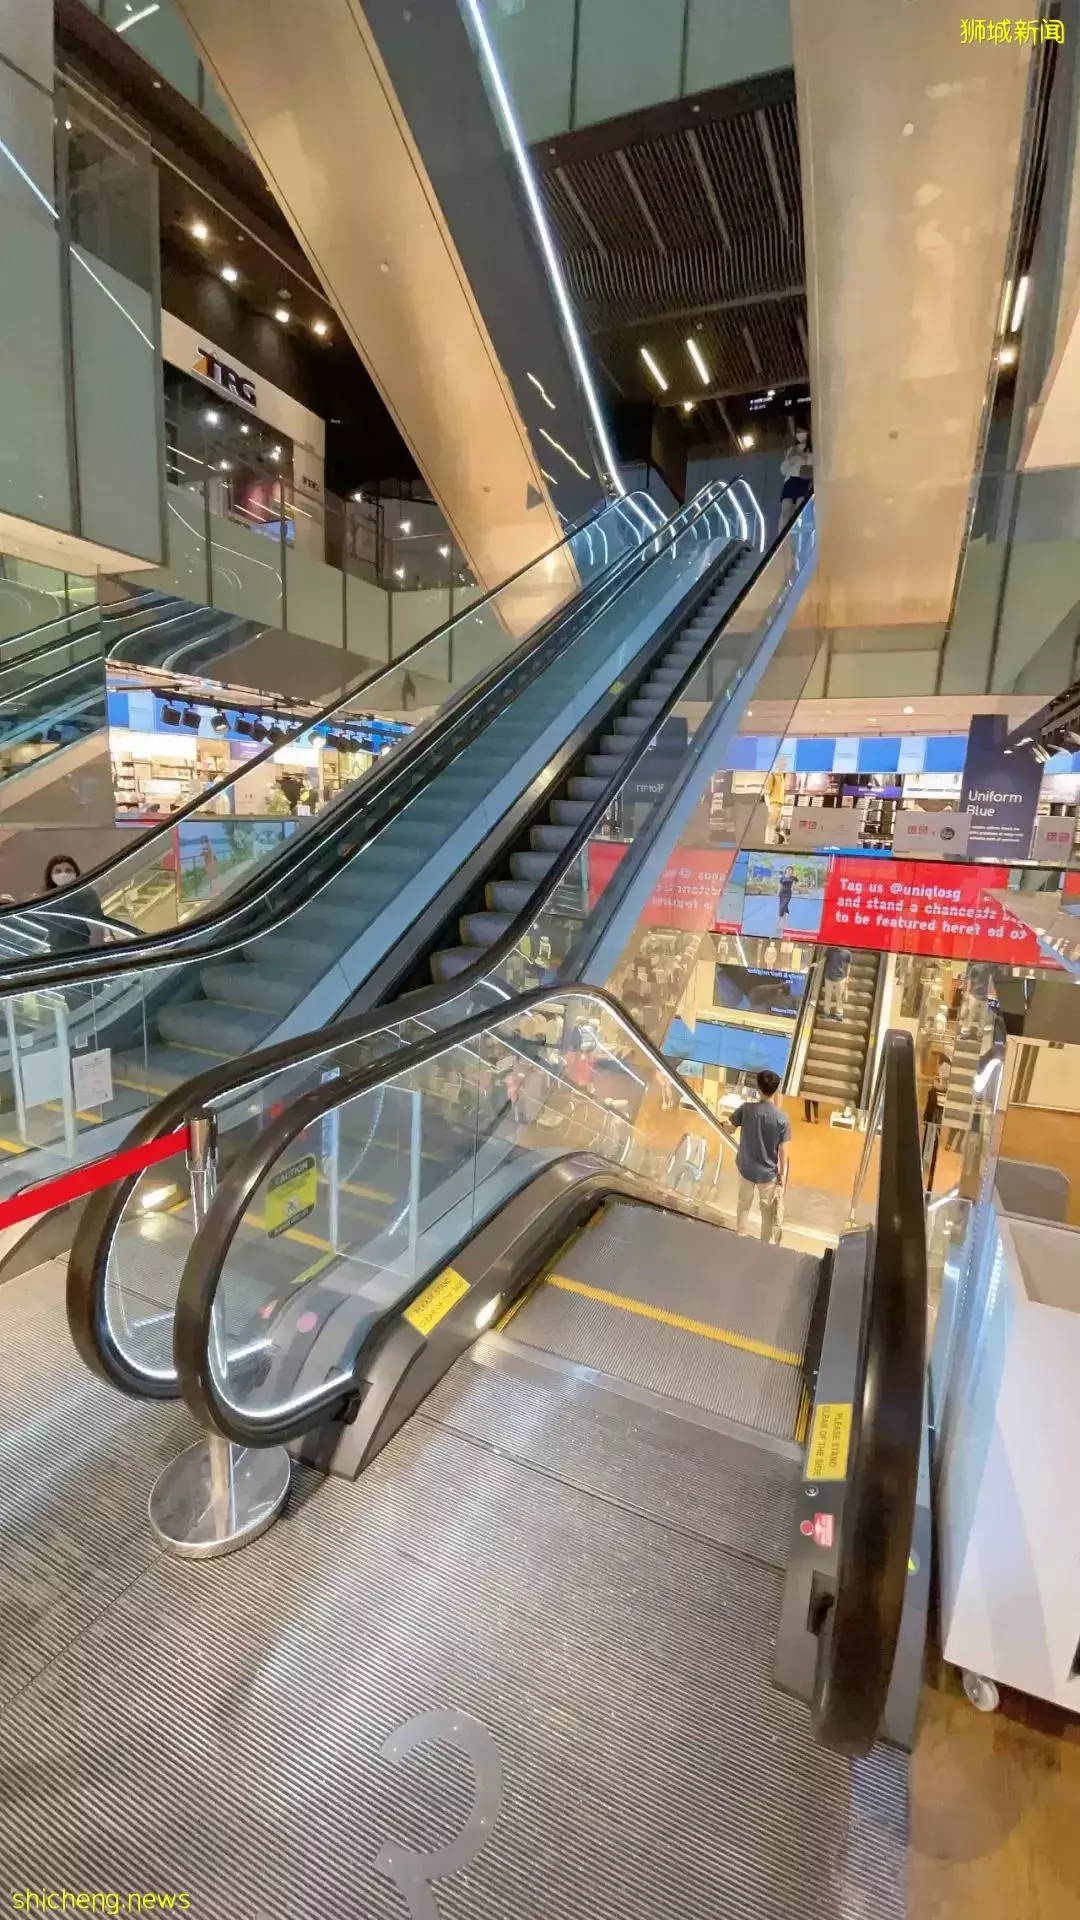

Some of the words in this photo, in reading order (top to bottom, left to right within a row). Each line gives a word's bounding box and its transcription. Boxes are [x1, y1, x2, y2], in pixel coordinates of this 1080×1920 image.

[968, 789, 1023, 803] Uniform
[966, 804, 996, 817] Blue
[840, 878, 863, 894] Tag
[868, 883, 883, 893] us
[890, 882, 961, 902] @uniqlosg
[837, 896, 861, 909] and
[866, 897, 904, 912] stand
[910, 903, 919, 913] a
[835, 910, 849, 923] to
[854, 912, 870, 925] be
[876, 914, 936, 931] featured
[273, 1160, 309, 1185] CAUTION
[820, 1405, 830, 1429] CLEAR
[832, 1412, 844, 1440] PLEASE
[819, 1430, 827, 1441] OF
[816, 1441, 826, 1457] THE
[829, 1442, 840, 1467] STAND
[812, 1458, 824, 1477] SIDE
